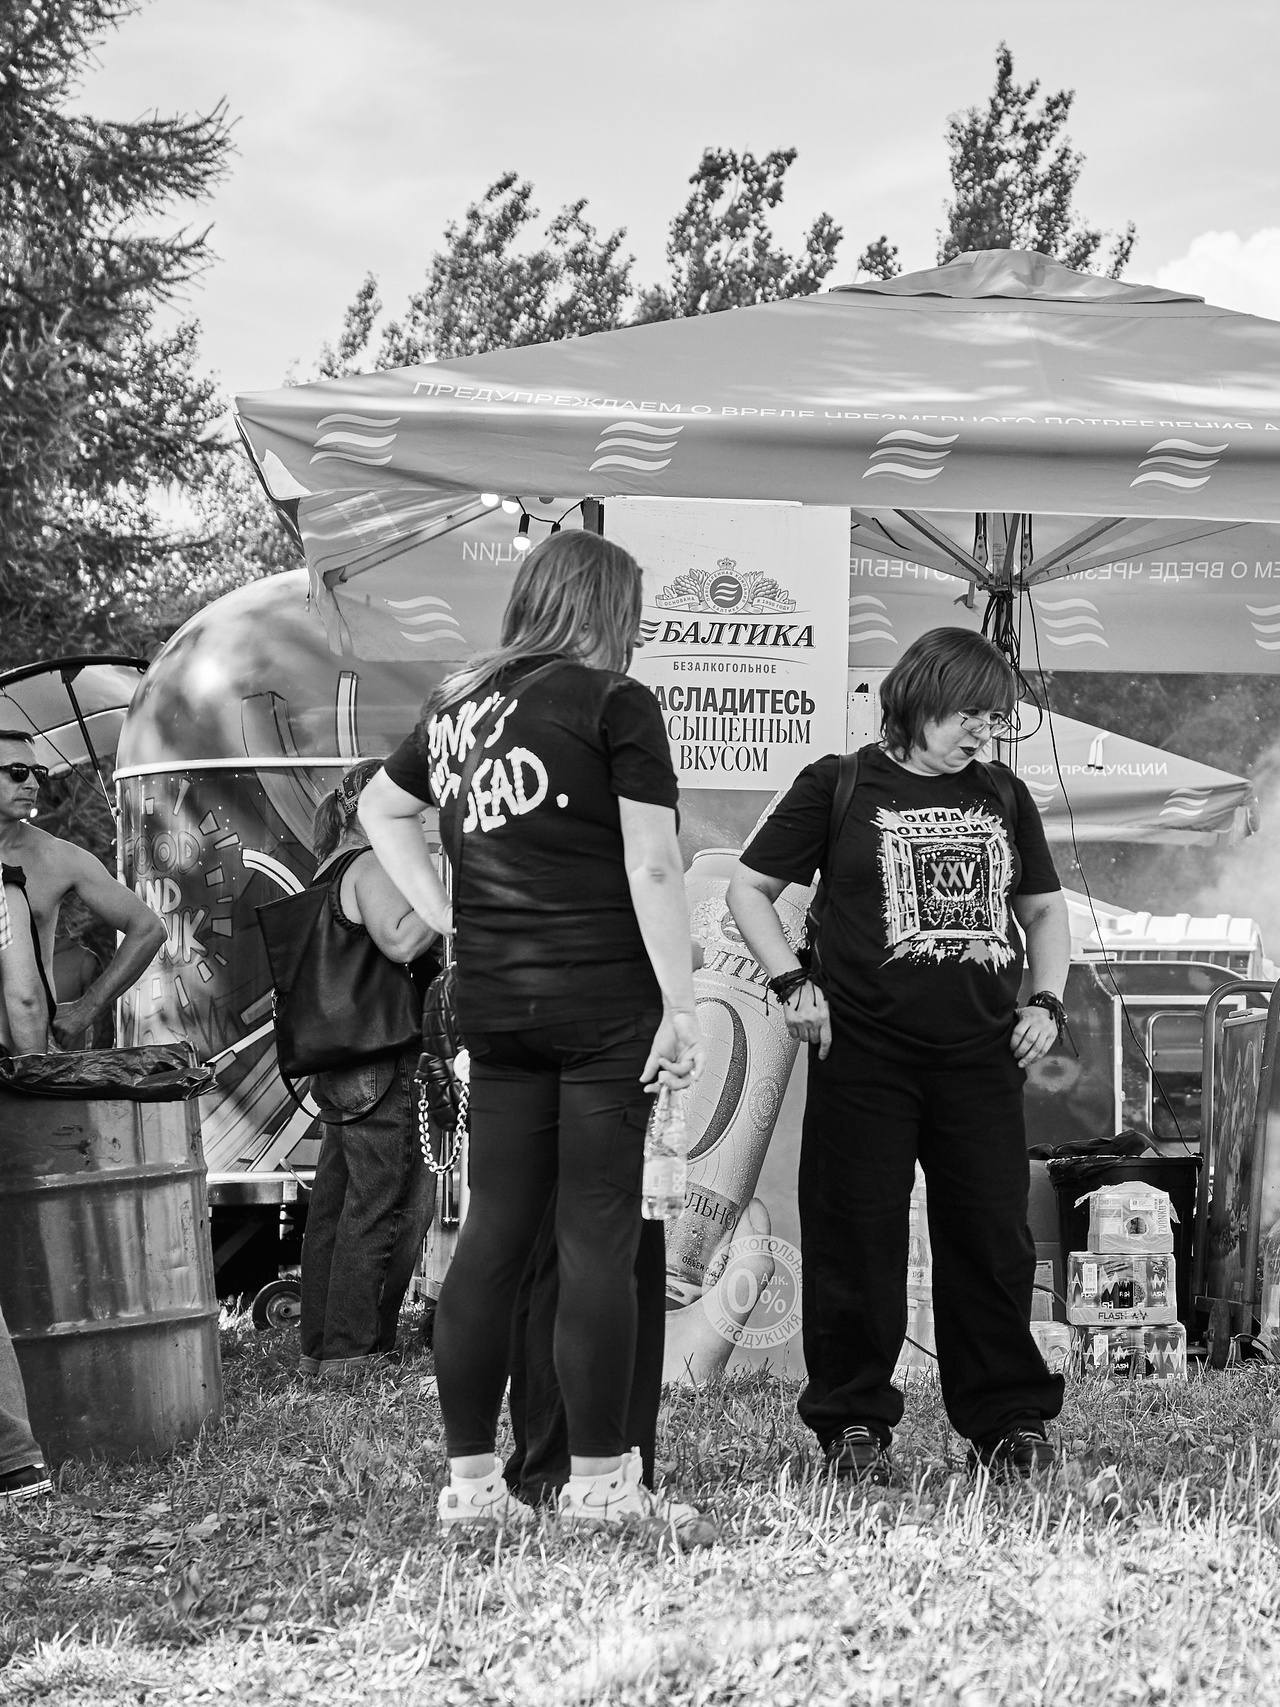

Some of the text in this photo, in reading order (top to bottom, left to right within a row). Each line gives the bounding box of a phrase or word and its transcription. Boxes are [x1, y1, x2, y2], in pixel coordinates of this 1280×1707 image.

[413, 381, 681, 413] ПРЕДУПРЕЖДАЕМ
[691, 405, 712, 415] О
[659, 620, 816, 649] БАЛТИКА
[673, 661, 777, 674] БЕЗАЛКОГОЛЬНОЕ
[648, 685, 816, 716] АСЛАДИТЕСЬ
[427, 691, 518, 763] UNK'S
[667, 714, 811, 745] СЫЩЕННЫМ
[680, 745, 768, 771] ВКУСОМ
[1060, 762, 1168, 777] ПРОДУКЦИИ
[897, 821, 992, 836] ОТКРОЙ!
[903, 811, 963, 823] ОКНА
[930, 862, 976, 889] XXV
[705, 1238, 802, 1288] БЕЗАЛКОГОЛЬН
[760, 1272, 789, 1286] Алк.
[715, 1313, 803, 1348] ПРОДУКЦИЯ
